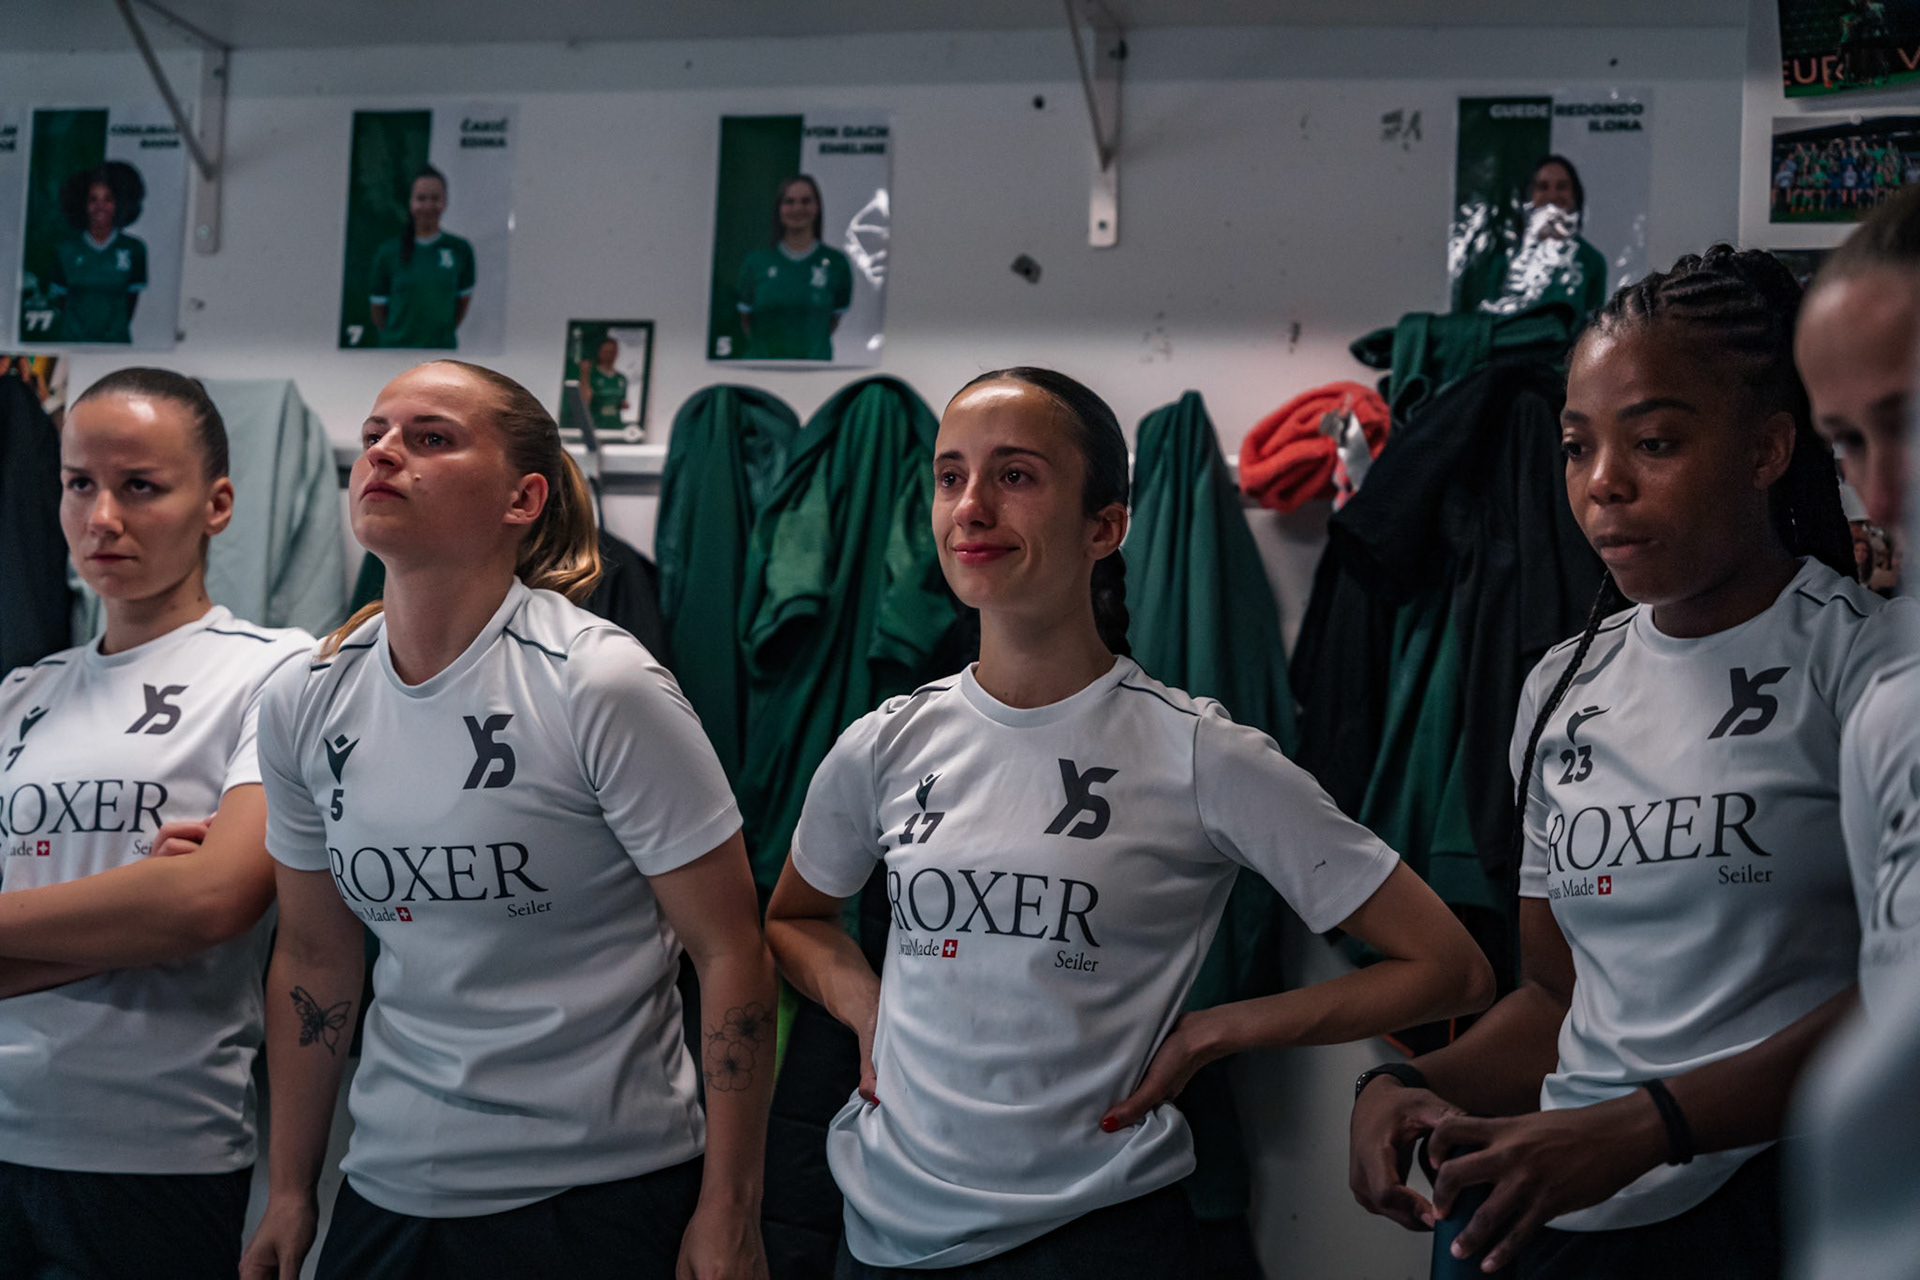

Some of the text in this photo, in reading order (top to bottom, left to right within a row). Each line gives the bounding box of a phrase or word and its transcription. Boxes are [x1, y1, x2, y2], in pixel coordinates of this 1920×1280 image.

[1489, 103, 1644, 119] GUEDE REDONDO
[1588, 119, 1643, 131] ILONA
[24, 310, 55, 331] 77
[347, 325, 364, 345] 7
[715, 335, 733, 357] 5
[1557, 744, 1593, 785] 23
[330, 789, 344, 821] 5
[898, 811, 945, 845] 17
[1547, 792, 1772, 876] ROXER
[329, 842, 549, 903] ROXER
[1718, 864, 1773, 885] Seiler
[1562, 877, 1595, 898] Made
[363, 907, 397, 922] Made
[506, 900, 552, 918] Seiler
[888, 868, 1101, 948] ROXER
[910, 938, 939, 957] Made
[1054, 950, 1099, 972] Seiler
